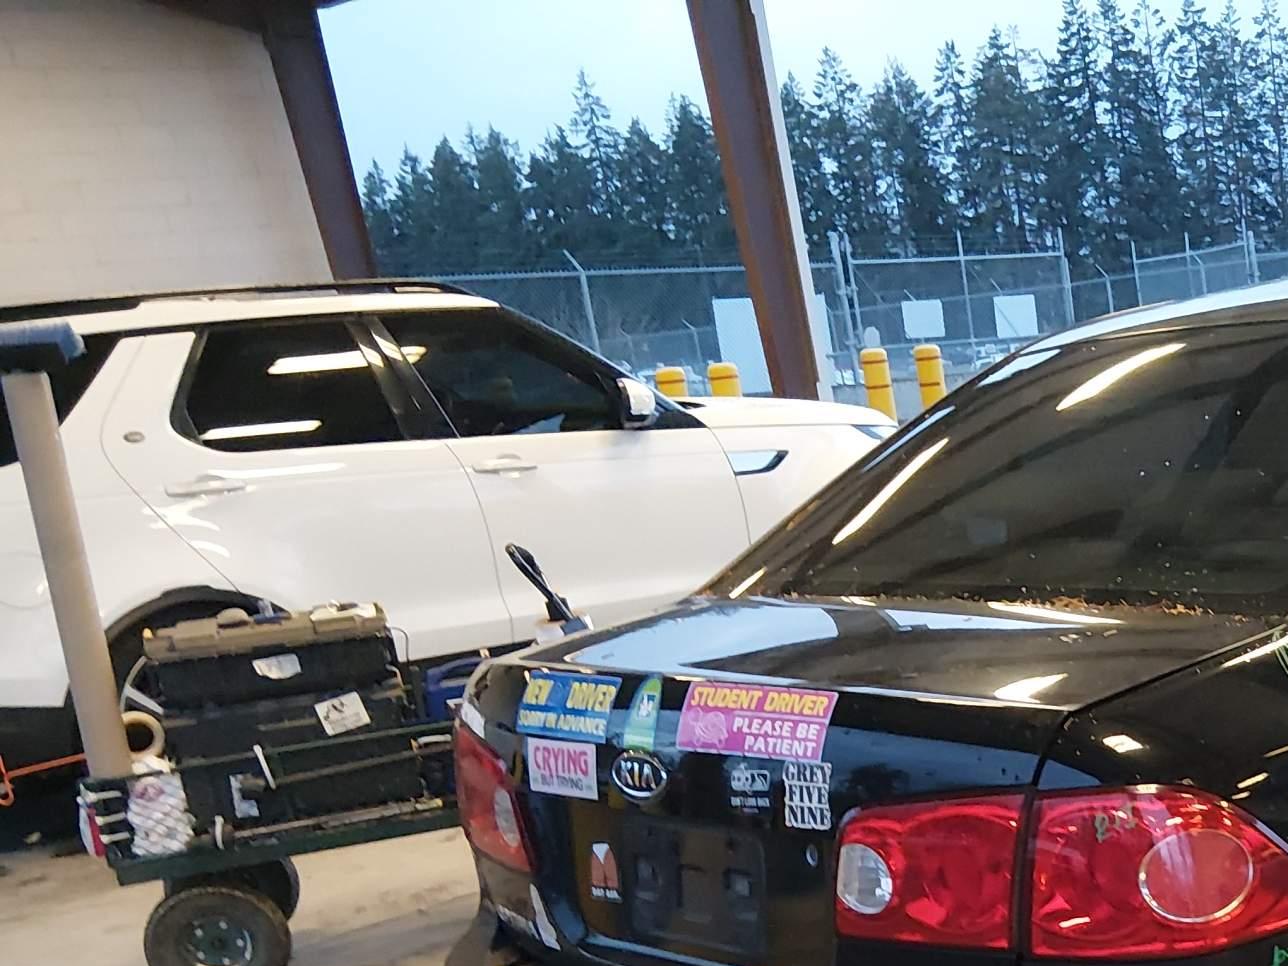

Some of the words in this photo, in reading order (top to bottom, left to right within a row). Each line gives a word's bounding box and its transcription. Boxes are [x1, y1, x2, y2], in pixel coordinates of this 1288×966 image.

[523, 678, 554, 706] NEW
[566, 682, 616, 712] DRIVER
[691, 687, 763, 710] STUDENT
[763, 692, 829, 716] DRIVER
[557, 713, 607, 736] ADVANCE
[732, 717, 795, 738] PLEASE
[796, 724, 820, 740] BE
[744, 735, 817, 757] PATIENT
[534, 746, 589, 778] CRYING
[785, 762, 831, 784] GREY
[556, 775, 584, 791] TRYING
[620, 759, 657, 789] KIA
[788, 784, 829, 804] FIVE
[788, 804, 832, 826] NINE
